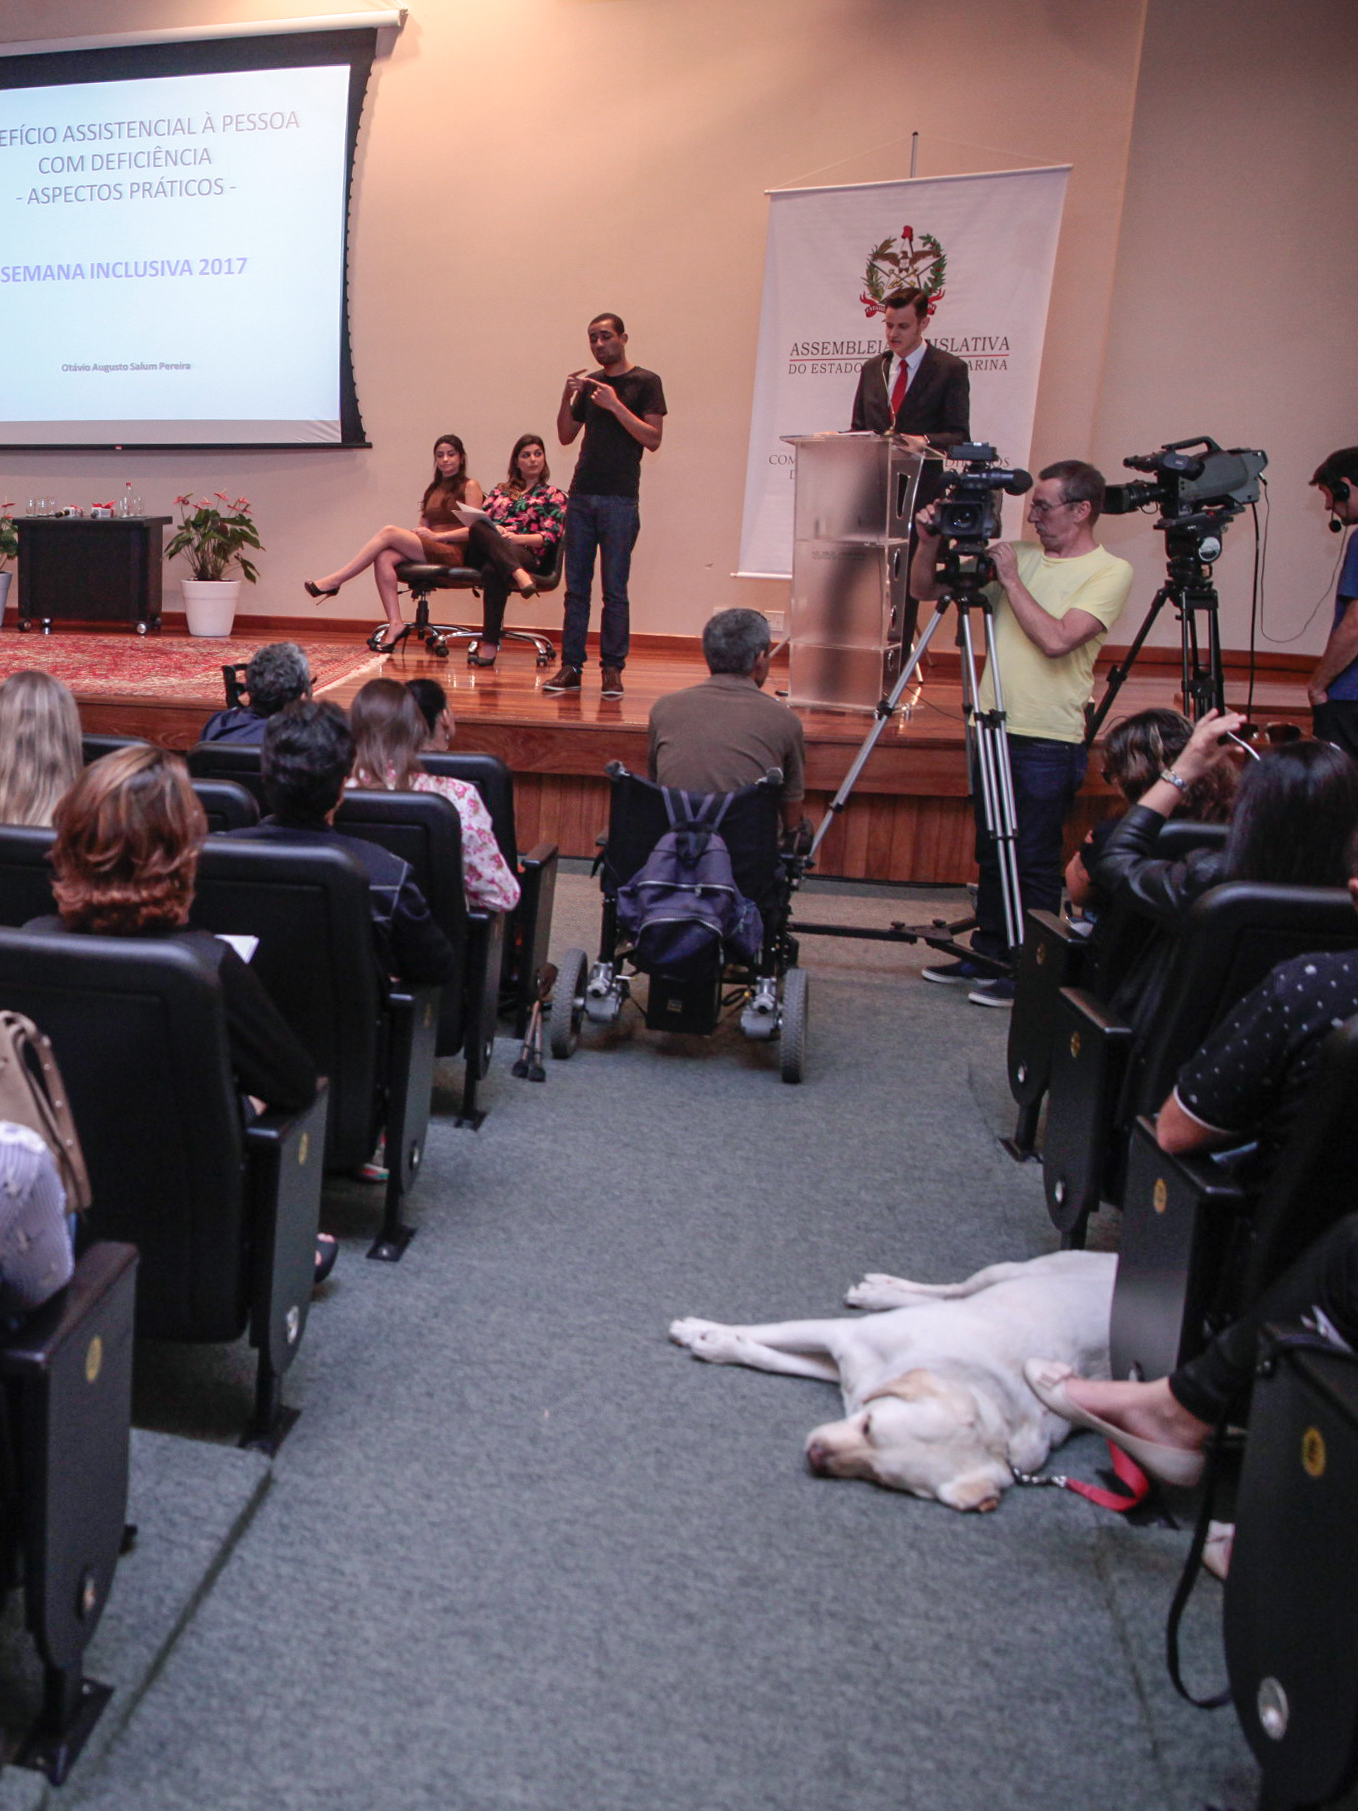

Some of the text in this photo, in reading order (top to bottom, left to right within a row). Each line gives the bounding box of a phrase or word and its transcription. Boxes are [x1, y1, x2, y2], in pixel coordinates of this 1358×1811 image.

[62, 117, 197, 143] ASSISTENCIAL
[201, 111, 216, 134] À
[222, 111, 300, 133] PESSOA
[38, 145, 213, 175] COM DEFICIÊNCIA
[27, 183, 123, 205] ASPECTOS
[129, 176, 224, 199] PRÁTICOS
[0, 257, 248, 283] SEMANA INCLUSIVA 2017
[932, 336, 1010, 352] ISLATIVA
[61, 361, 191, 374] Otávio Augusto Salum Pereira
[788, 358, 1008, 375] DO ESTADO ARINA
